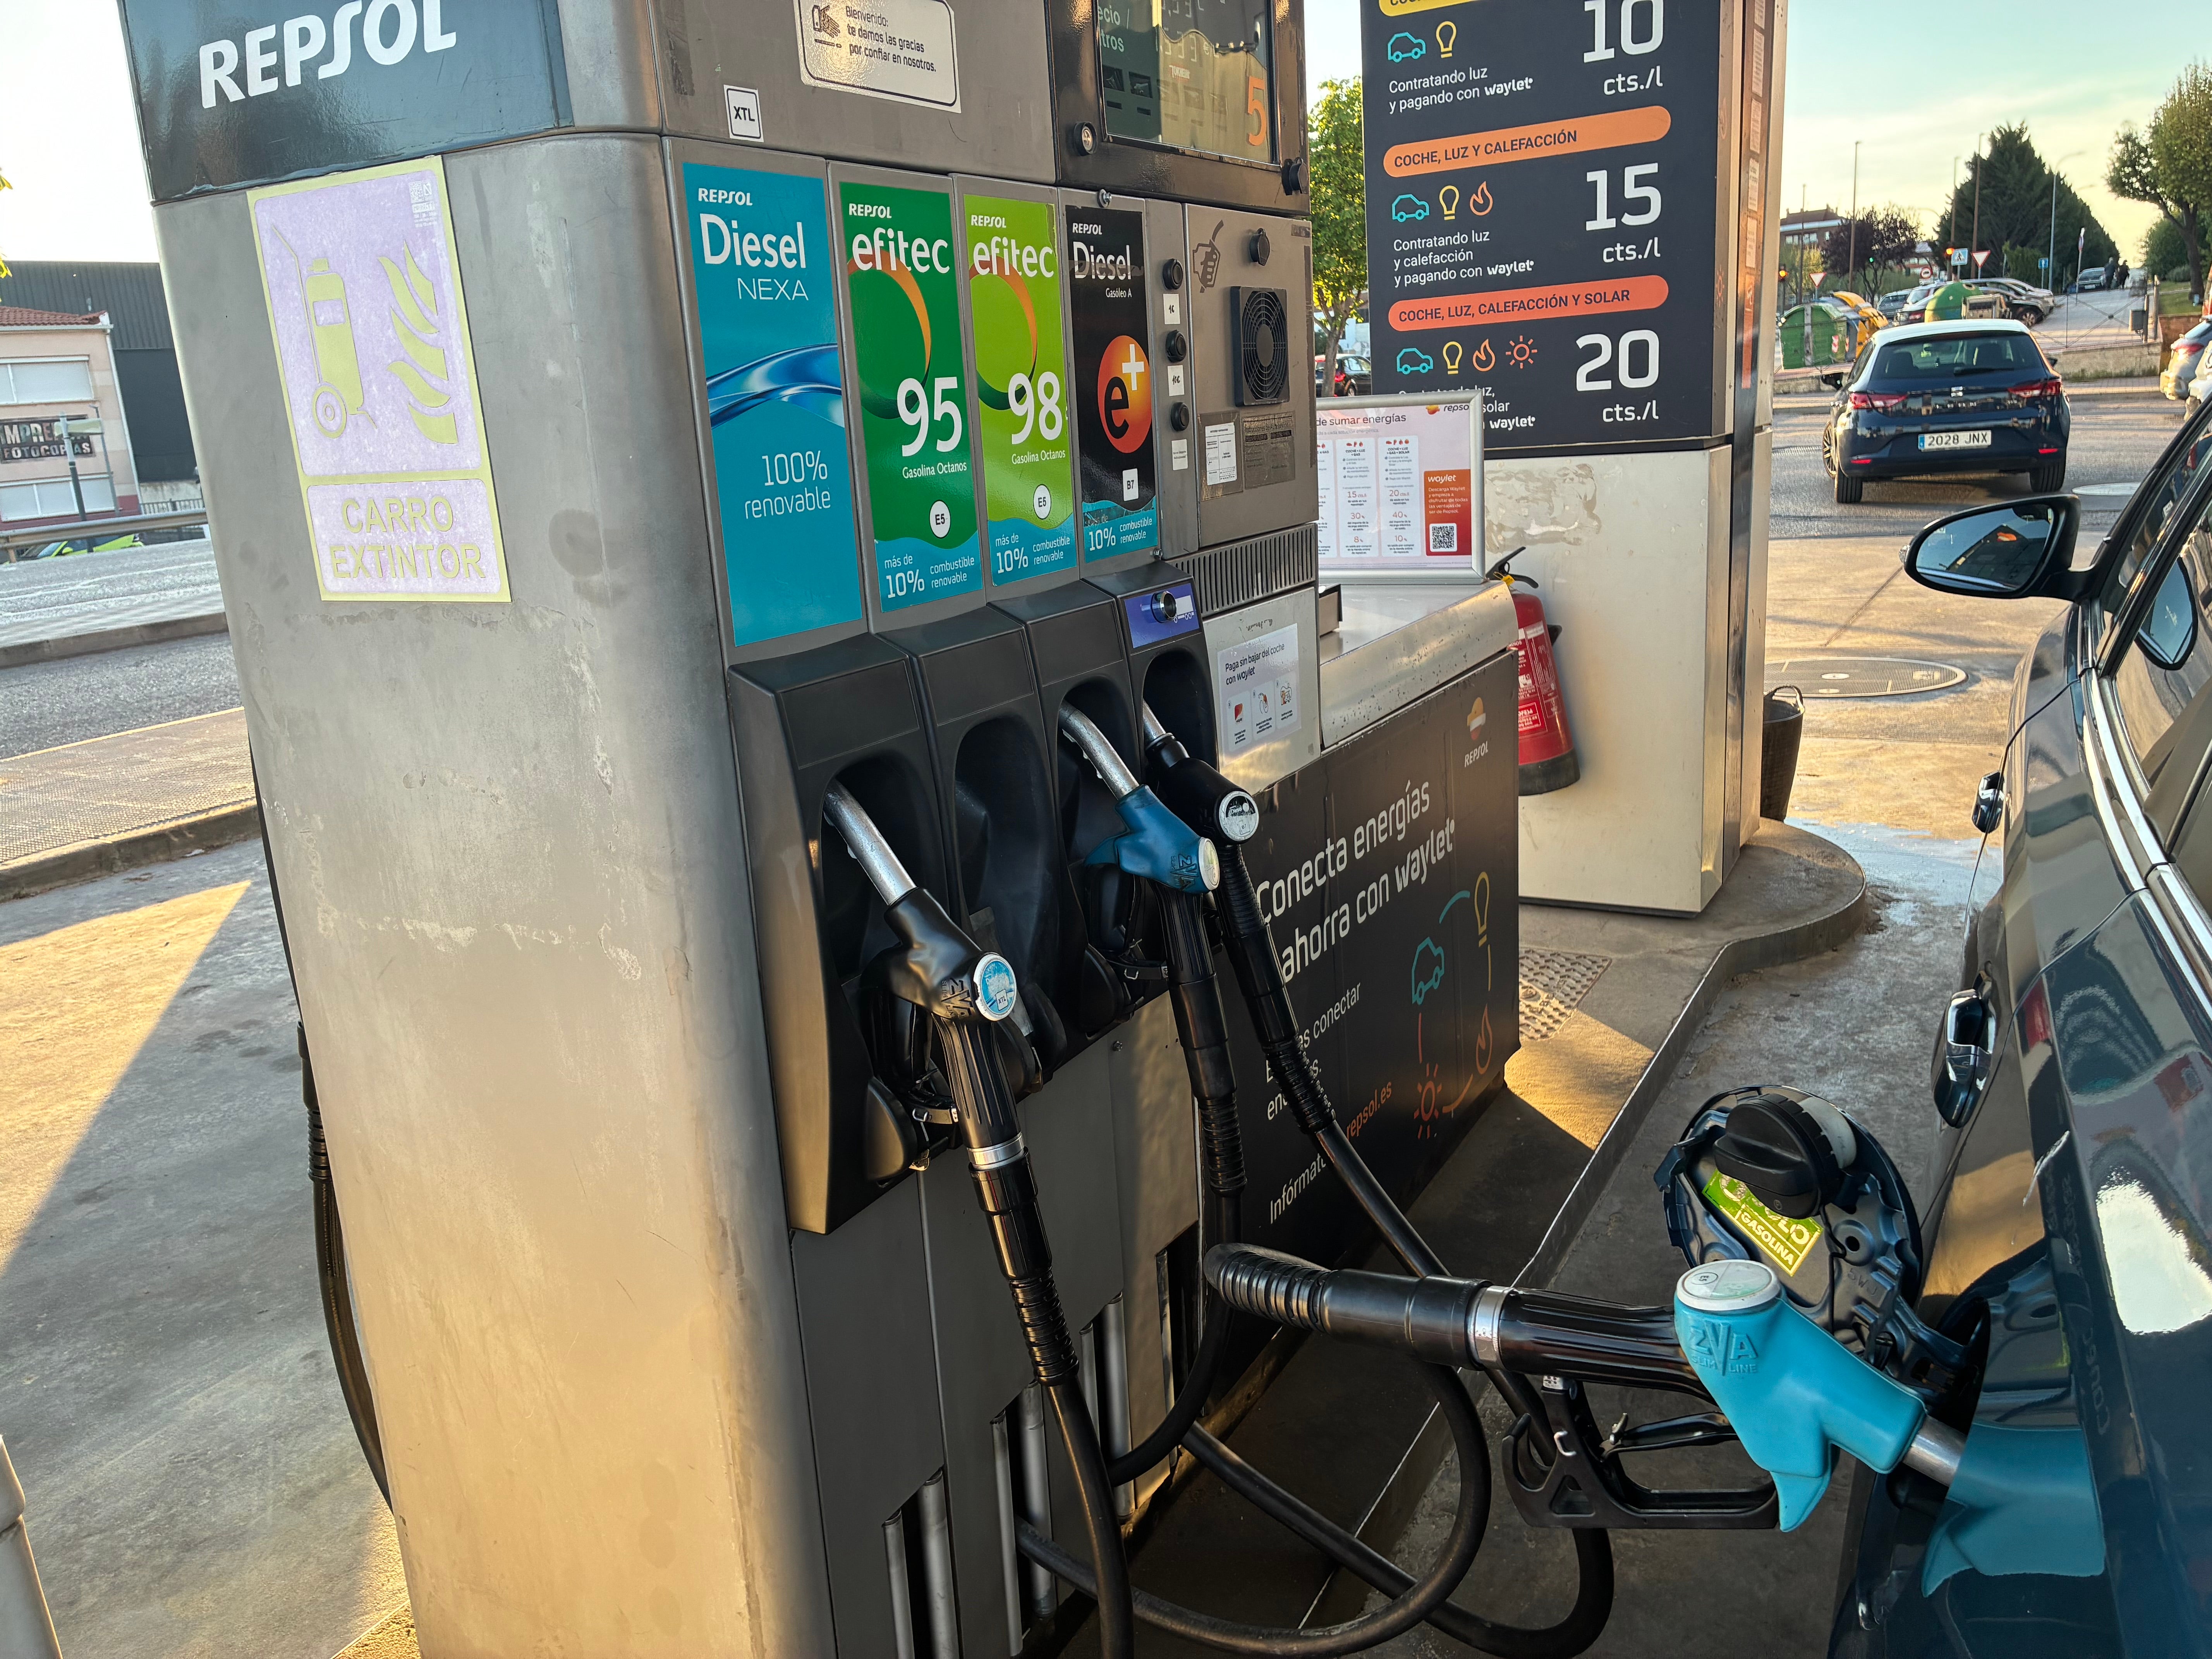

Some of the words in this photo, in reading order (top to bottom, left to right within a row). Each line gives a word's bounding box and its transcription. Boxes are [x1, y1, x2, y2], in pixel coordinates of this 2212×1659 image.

[846, 6, 888, 27] Bienvenido:
[1098, 5, 1120, 26] ecio
[847, 24, 856, 36] te
[858, 26, 883, 43] damos
[886, 32, 896, 46] las
[899, 38, 924, 52] gracias
[1101, 29, 1124, 52] tros
[1584, 0, 1664, 63] 10
[199, 0, 456, 108] REPSOL
[849, 44, 862, 56] por
[864, 48, 890, 61] confiar
[892, 54, 901, 64] en
[903, 56, 936, 72] nosotros.
[1389, 69, 1466, 93] Contratando
[1470, 67, 1488, 80] luz
[1604, 65, 1663, 95] cts./l
[1389, 101, 1396, 114] y
[1400, 90, 1453, 113] pagando
[1456, 88, 1480, 101] con
[1484, 77, 1533, 96] waylet
[733, 106, 755, 122] XTL
[1248, 76, 1267, 146] 5
[1394, 151, 1441, 168] COCHE,
[1445, 146, 1468, 161] LUZ
[1472, 144, 1480, 156] Y
[1484, 129, 1577, 155] CALEFACCIÓN
[698, 187, 752, 206] REPSOL
[1586, 162, 1661, 231] 15
[849, 203, 891, 218] REPSOL
[971, 215, 1006, 228] REPSOL
[700, 213, 806, 268] Diesel
[1072, 223, 1103, 235] REPSOL
[1393, 232, 1468, 251] Contratando
[1472, 230, 1490, 242] luz
[852, 227, 950, 273] efitec
[973, 236, 1054, 278] efitec
[1073, 241, 1131, 280] Diesel
[1394, 259, 1400, 271] y
[1403, 249, 1473, 267] calefacción
[1603, 237, 1661, 263] cts./l
[1394, 276, 1401, 288] y
[1404, 268, 1456, 287] pagando
[1460, 266, 1482, 278] con
[1487, 259, 1534, 276] waylet
[737, 278, 809, 301] NEXA
[1106, 288, 1127, 298] Gasóleo
[1128, 288, 1132, 297] A
[1399, 307, 1444, 322] COCHE,
[1448, 305, 1475, 318] LUZ,
[1478, 294, 1568, 315] CALEFACCIÓN
[1572, 294, 1580, 306] Y
[1584, 290, 1630, 305] SOLAR
[1576, 329, 1659, 391] 20
[897, 376, 962, 457] 95
[1008, 371, 1063, 445] 98
[1316, 418, 1327, 426] de
[1329, 417, 1360, 426] sumar
[1363, 414, 1407, 424] energías
[1444, 404, 1469, 413] repso
[1603, 400, 1659, 422] cts./l
[1489, 416, 1535, 431] waylet
[4, 442, 90, 459] FOTOCOPAS
[1928, 434, 1959, 446] 2028
[1965, 432, 1987, 444] JNX
[762, 450, 828, 486] 100%
[902, 464, 935, 479] Gasolina
[937, 461, 967, 474] Octanos
[1012, 451, 1039, 464] Gasolina
[1041, 449, 1066, 460] Octanos
[1127, 479, 1134, 490] B7
[342, 496, 453, 533] CARRO
[745, 486, 831, 519] renovable
[1038, 496, 1046, 508] E5
[935, 513, 945, 526] E5
[996, 534, 1010, 547] más
[1011, 533, 1019, 543] de
[1089, 527, 1116, 551] 10%
[1120, 517, 1152, 532] combustible
[1120, 530, 1146, 544] renovable
[329, 543, 486, 578] EXTINTOR
[884, 555, 902, 569] más
[903, 553, 913, 565] de
[996, 547, 1029, 574] 10%
[1033, 536, 1070, 552] combustible
[1034, 550, 1063, 565] renovable
[886, 569, 925, 598] 10%
[930, 556, 975, 575] combustible
[931, 571, 967, 588] renovable
[1225, 661, 1239, 672] Paga
[1248, 653, 1261, 663] bajar
[1271, 643, 1285, 655] coche
[1226, 675, 1236, 685] con
[1464, 740, 1488, 768] REPSOL
[1257, 836, 1347, 923] Conecta
[1354, 780, 1430, 860] energías
[1283, 903, 1350, 983] ahorra
[1356, 873, 1389, 924] con
[1395, 818, 1455, 893] waylet
[1314, 982, 1361, 1039] conectar
[1346, 1081, 1392, 1140] repsol.es
[1741, 1212, 1794, 1265] GASOLINA
[1729, 1363, 1757, 1373] LINE
